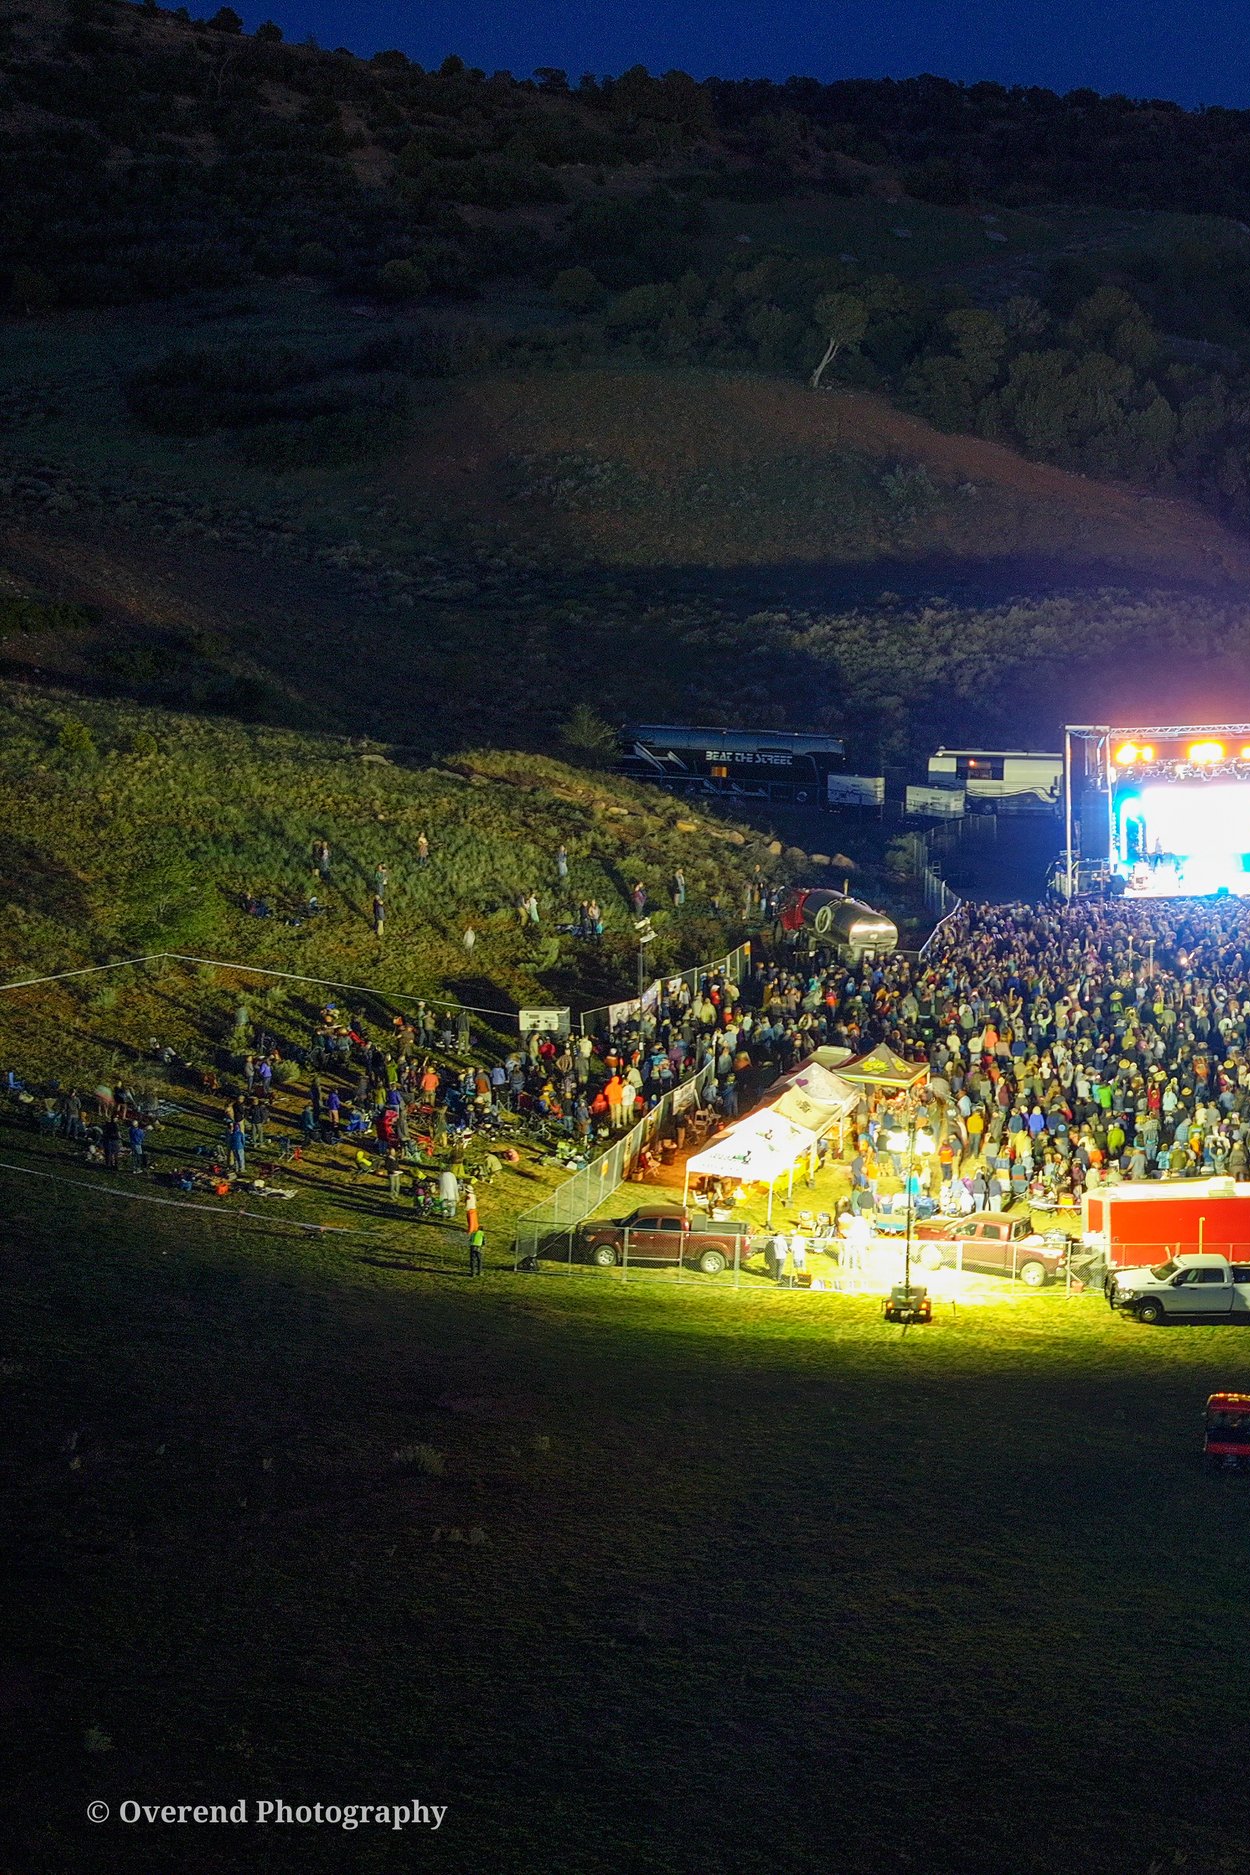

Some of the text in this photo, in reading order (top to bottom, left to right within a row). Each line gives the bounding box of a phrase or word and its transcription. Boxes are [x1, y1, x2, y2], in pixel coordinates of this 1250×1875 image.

[705, 750, 793, 765] BEAT THE STREET
